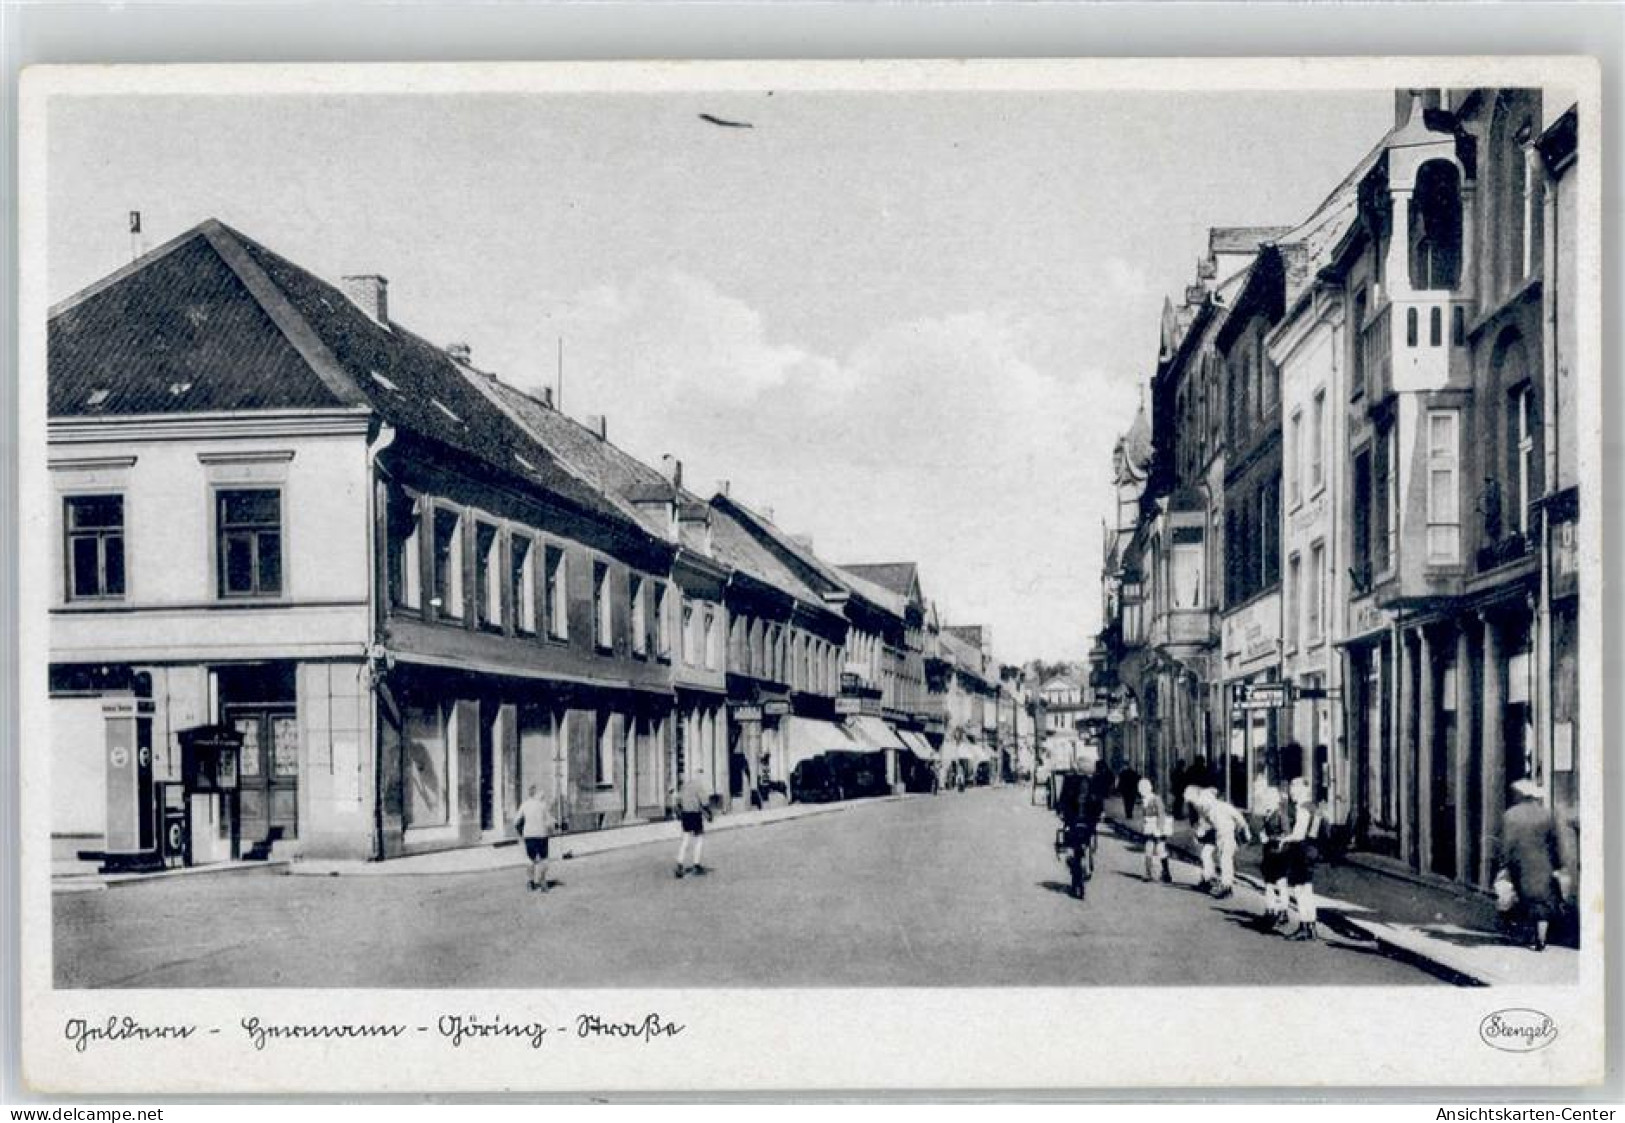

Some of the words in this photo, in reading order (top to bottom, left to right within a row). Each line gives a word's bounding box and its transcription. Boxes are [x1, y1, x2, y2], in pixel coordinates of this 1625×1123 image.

[65, 1016, 196, 1051] Geldern
[241, 1016, 406, 1050] Hermann
[438, 1014, 547, 1049] Göring
[576, 1013, 686, 1043] Straße
[1485, 1015, 1558, 1047] Stengel
